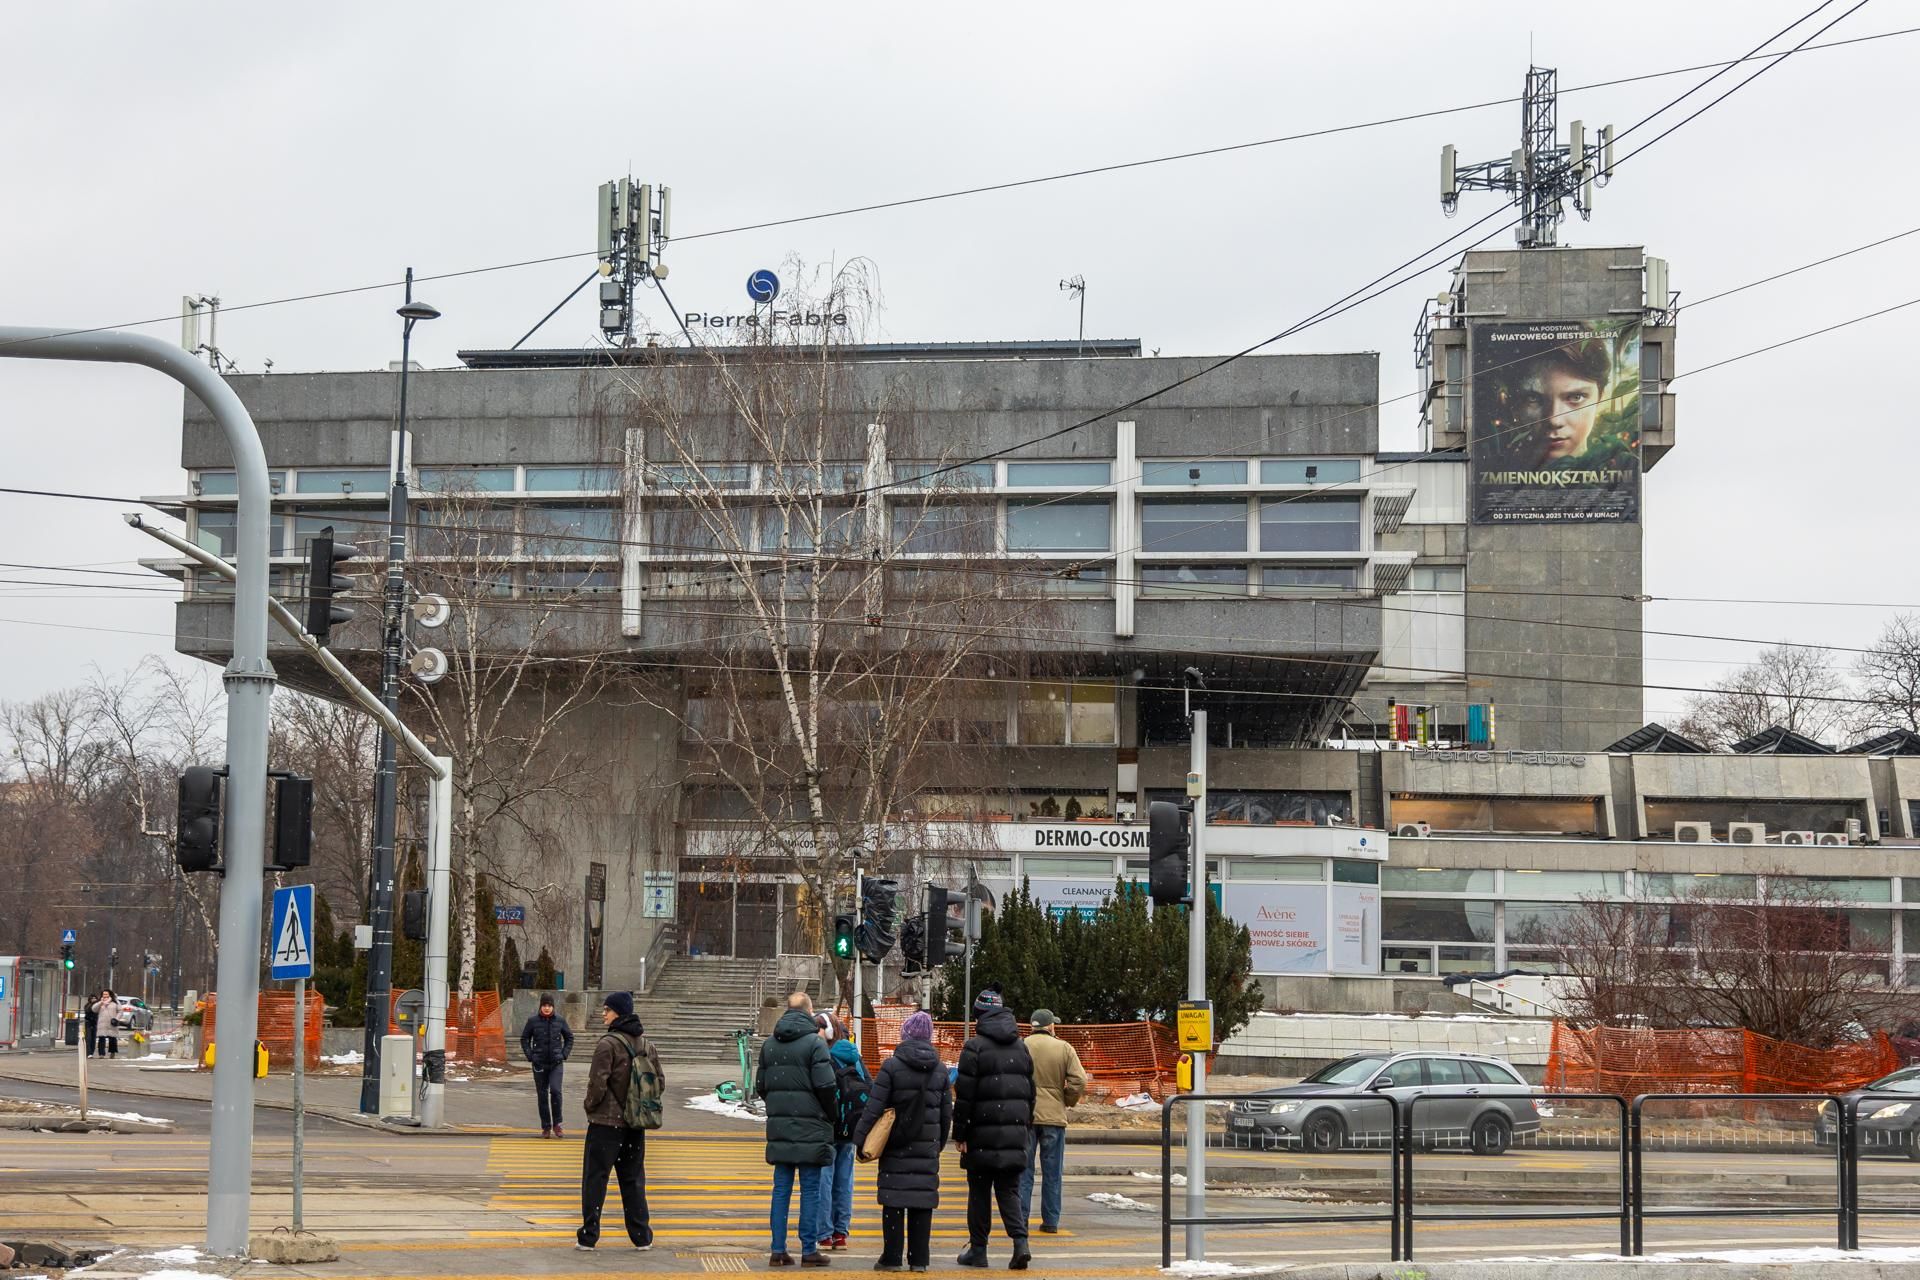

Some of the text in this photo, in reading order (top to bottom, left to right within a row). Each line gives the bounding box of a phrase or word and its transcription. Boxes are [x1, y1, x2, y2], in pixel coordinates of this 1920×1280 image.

[685, 310, 848, 328] Pierre Fabre
[1490, 331, 1619, 342] ŚWIATOWEGO BESTSELLERA
[1479, 469, 1633, 487] ZMIENNOKSZTAŁTNI
[1410, 747, 1587, 768] Pierre Fabre
[1062, 887, 1112, 896] CLEANANCE
[1256, 905, 1296, 920] Avène
[1248, 929, 1310, 939] EWNOŚĆ SIEBIE
[1286, 938, 1318, 948] SKÓRZE
[1181, 1011, 1205, 1019] UWAGA!
